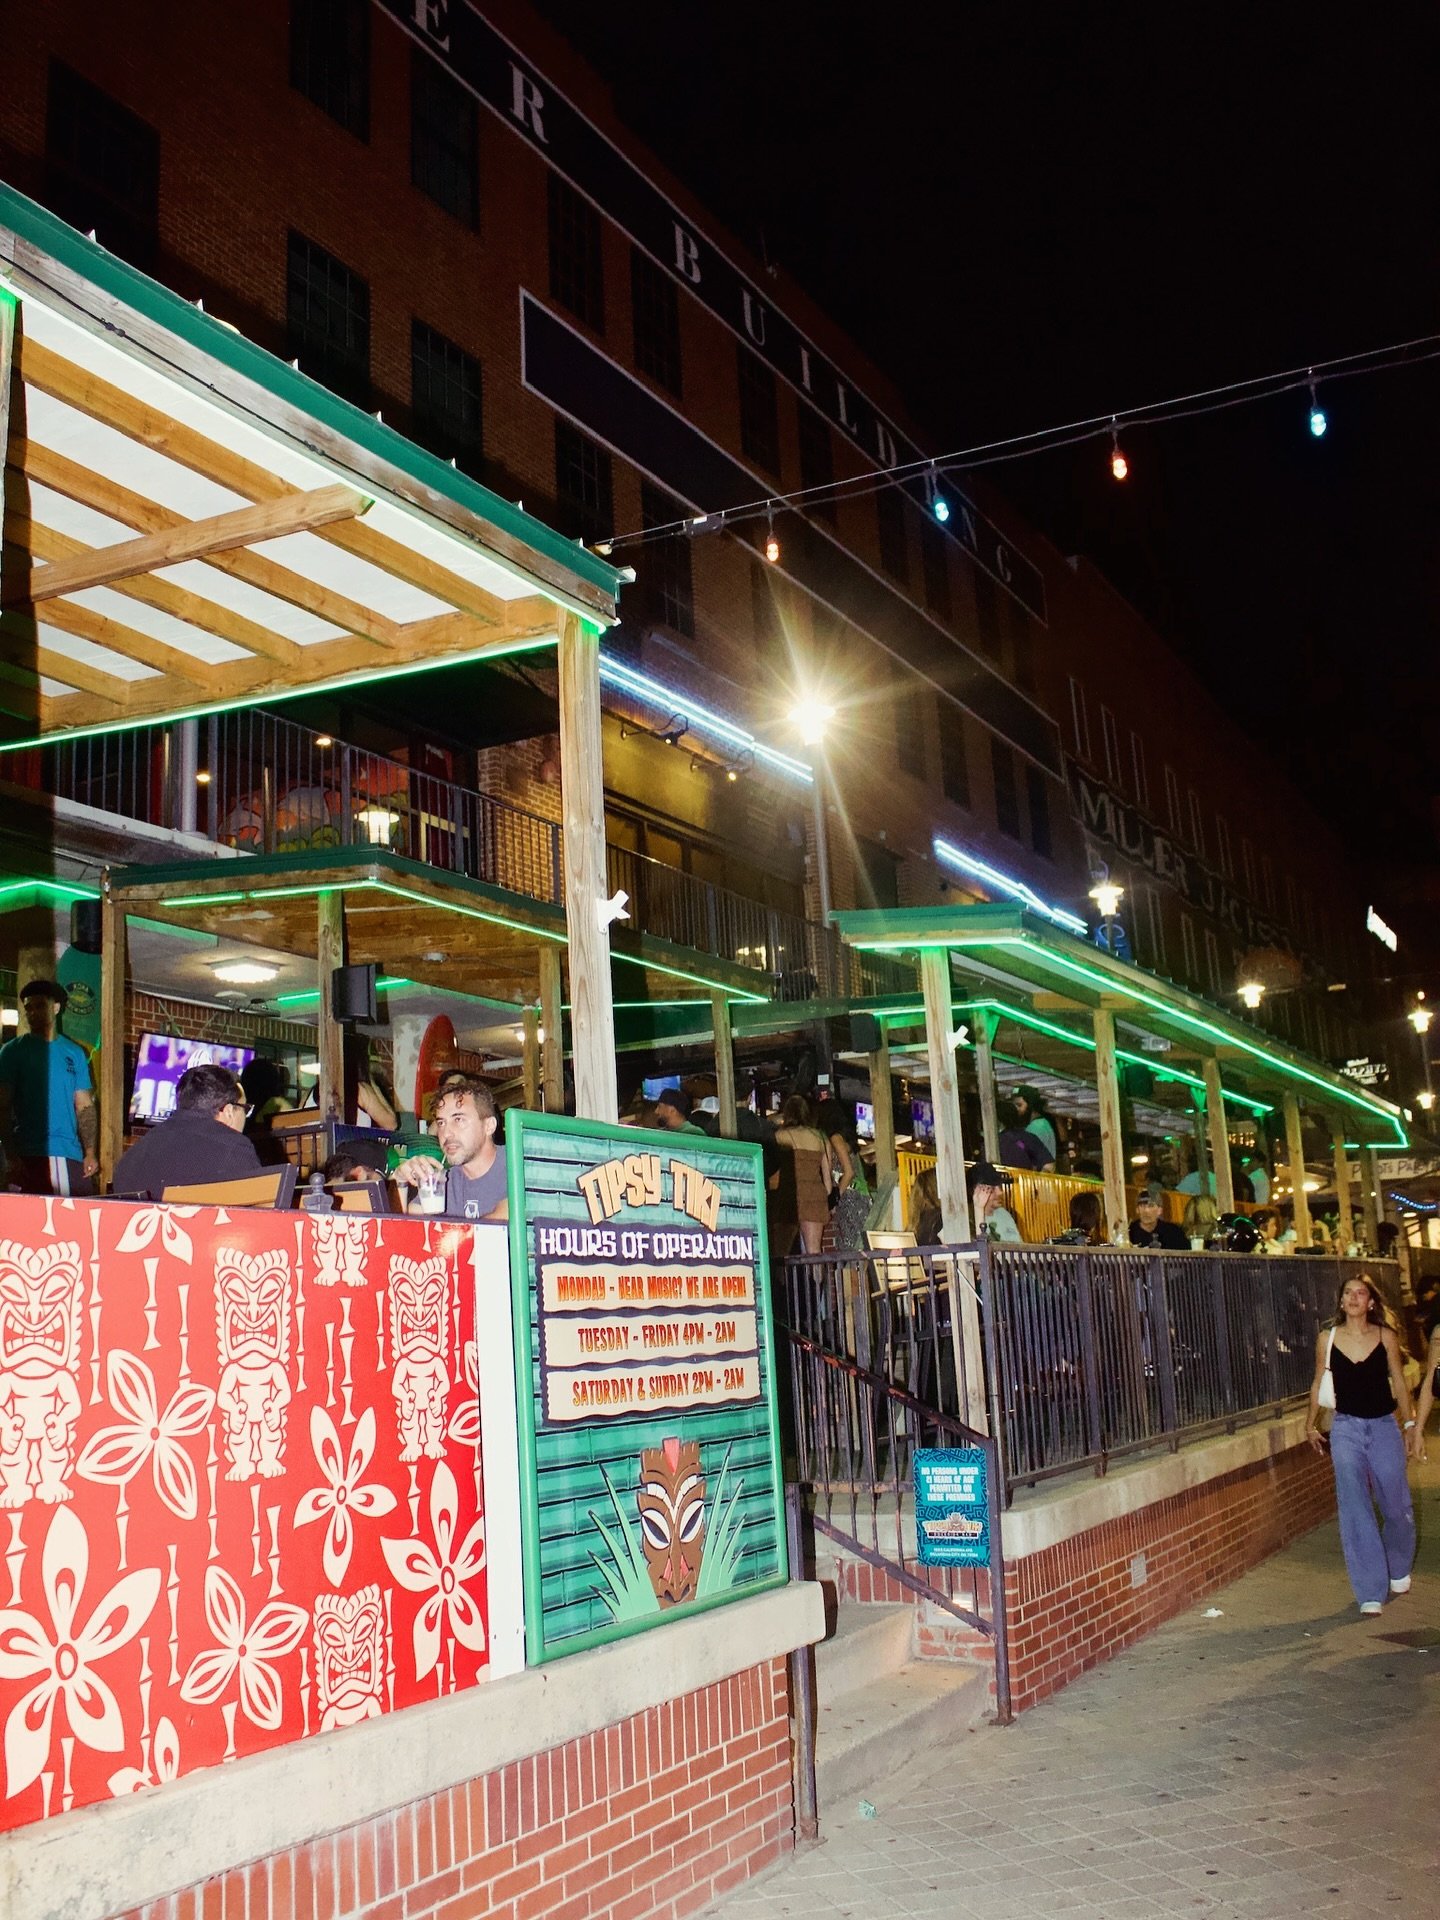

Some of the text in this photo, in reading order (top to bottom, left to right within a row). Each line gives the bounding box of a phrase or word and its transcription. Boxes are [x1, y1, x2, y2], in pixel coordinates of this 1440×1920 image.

[672, 222, 1014, 583] BUILDING
[1078, 778, 1190, 895] MILLER
[577, 1153, 722, 1232] TIPSY TIKI
[540, 1227, 754, 1260] HOURS OF OPERATION
[557, 1275, 605, 1302] MONDAY
[647, 1275, 682, 1300] MUSIC?
[686, 1275, 700, 1299] WE
[702, 1275, 720, 1299] ARE
[721, 1276, 747, 1298] OPEN!
[578, 1326, 629, 1353] TUESDAY
[642, 1324, 679, 1350] FRIDAY
[682, 1322, 704, 1345] 4PM
[714, 1321, 736, 1343] 2AM
[572, 1378, 633, 1407] SATURDAY
[637, 1377, 646, 1400] &
[649, 1372, 689, 1397] SUNDAY
[692, 1370, 713, 1394] 2PM
[724, 1367, 745, 1390] 2AM
